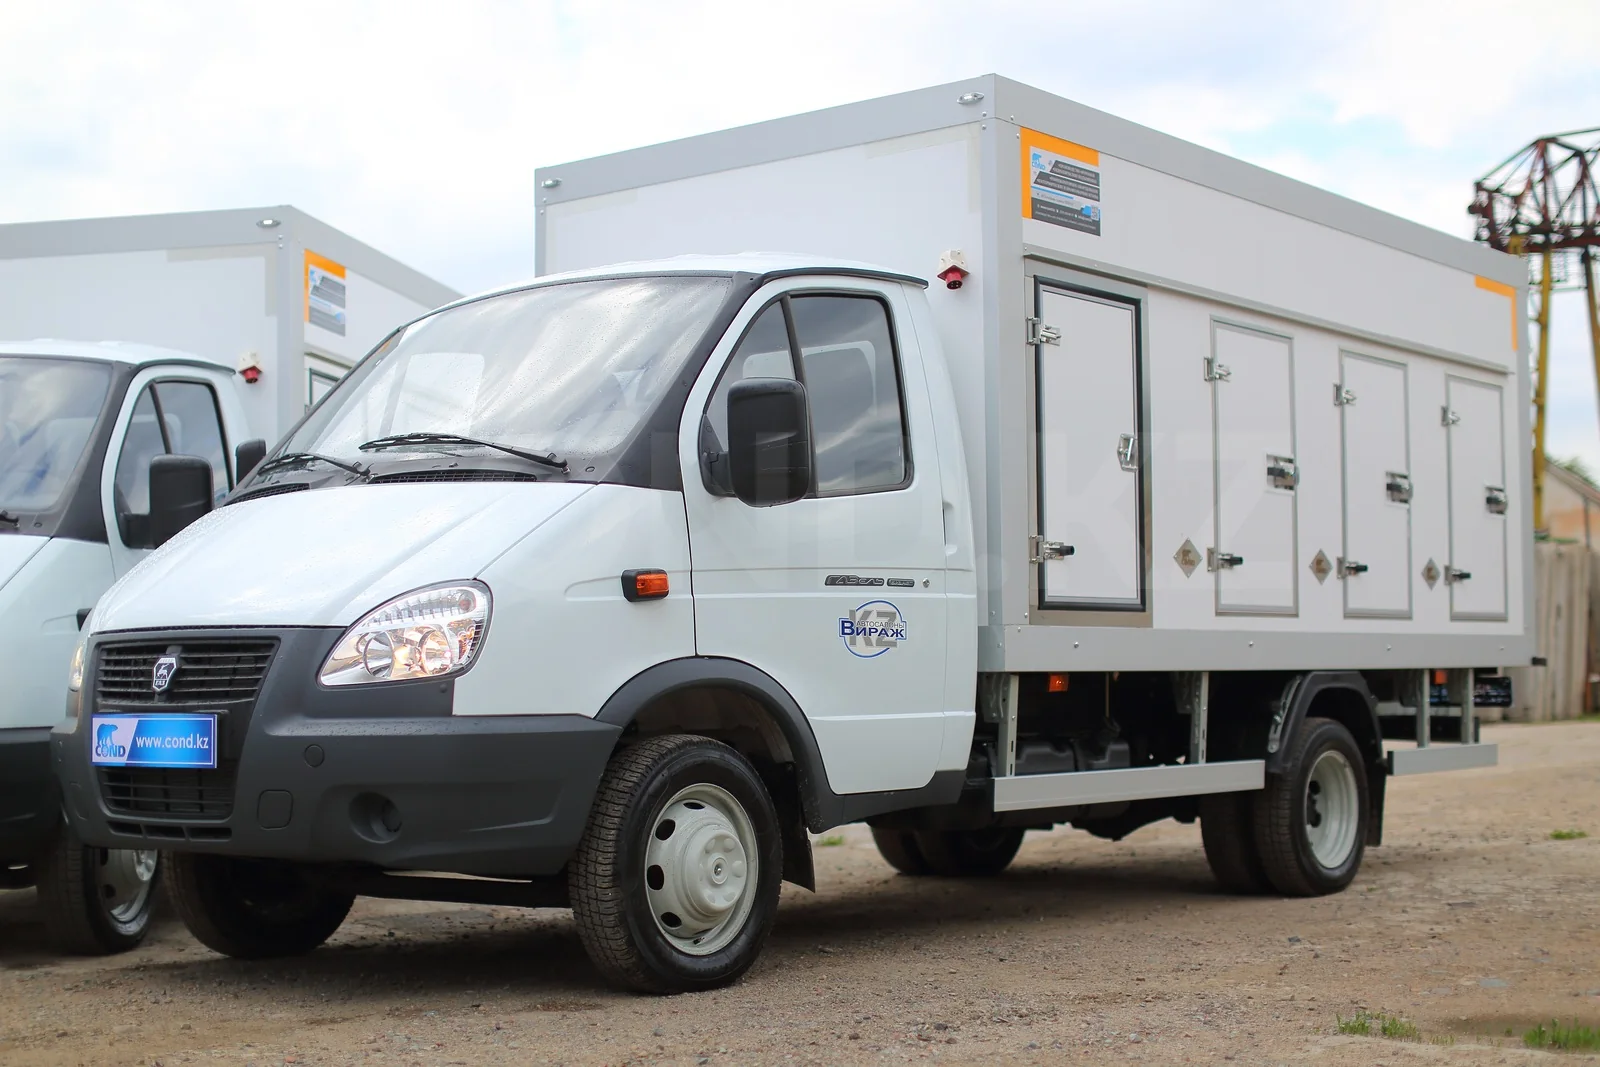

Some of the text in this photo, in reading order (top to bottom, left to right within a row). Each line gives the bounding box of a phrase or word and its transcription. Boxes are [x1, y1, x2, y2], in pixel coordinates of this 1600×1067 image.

[849, 609, 897, 648] KZ
[856, 620, 905, 628] АВТОСАЛОНЫ
[136, 734, 209, 749] www.cond.kz
[95, 745, 126, 757] COND
